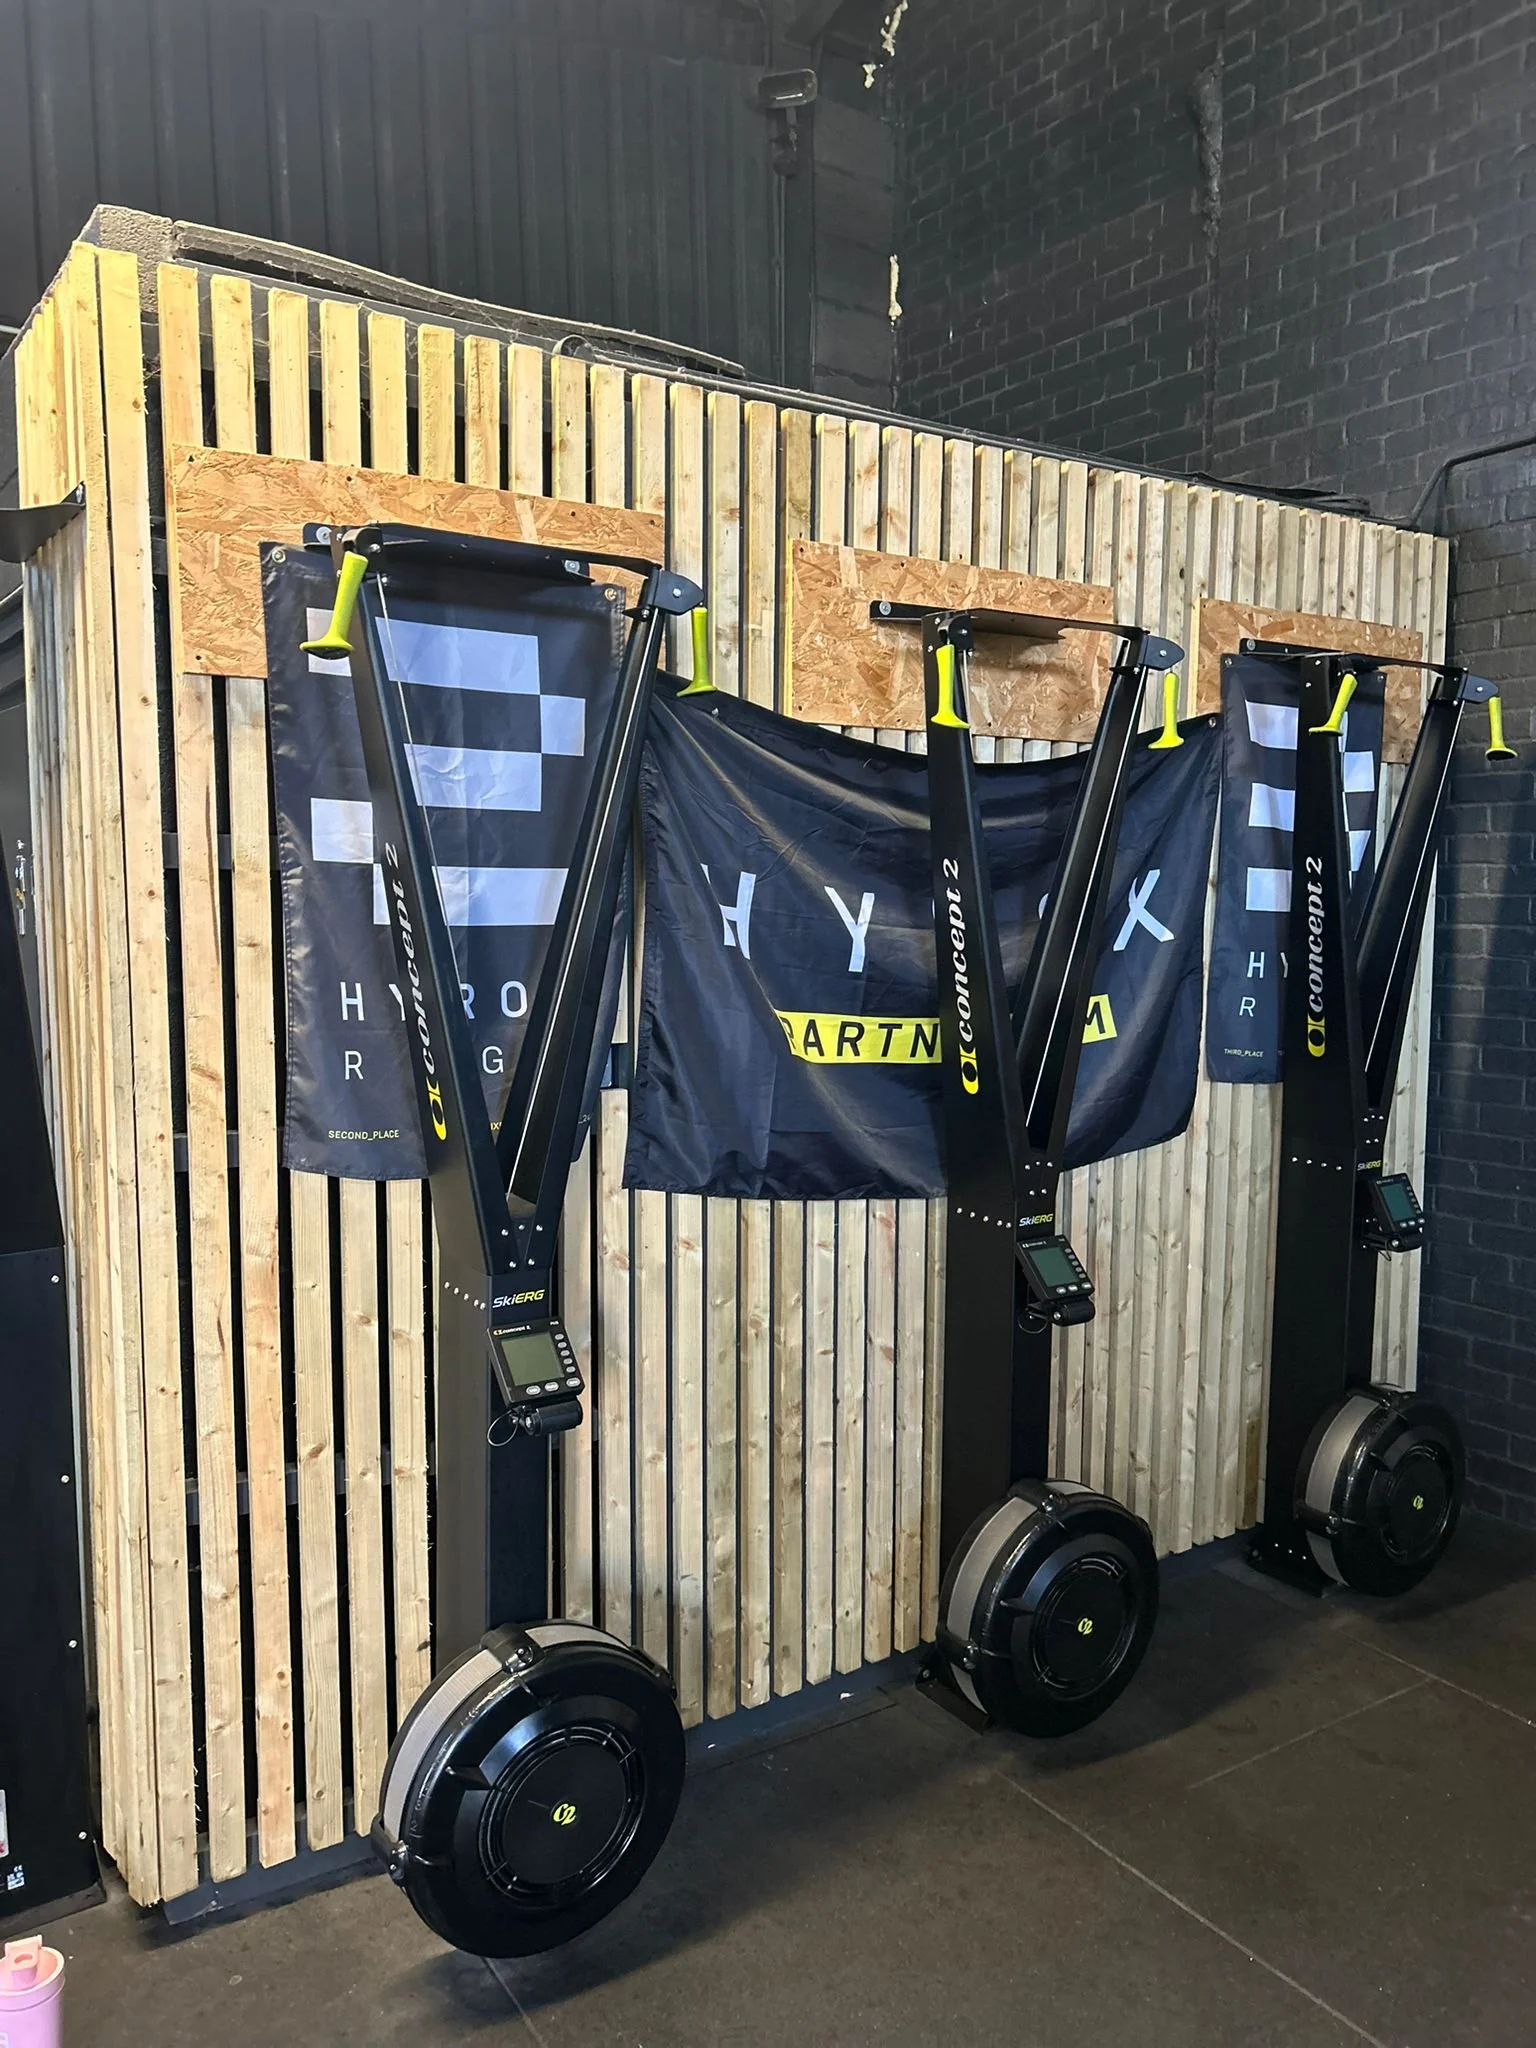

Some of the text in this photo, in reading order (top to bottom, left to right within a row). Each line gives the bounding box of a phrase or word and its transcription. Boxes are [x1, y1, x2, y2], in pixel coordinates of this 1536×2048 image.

[700, 863, 1175, 973] HYX
[1305, 856, 1325, 1014] concept 2
[385, 842, 437, 1076] concept 2
[943, 857, 973, 1043] concept 2
[1223, 1048, 1264, 1058] THIRD_PLACE
[328, 1128, 400, 1142] SECOND_PLACE
[1019, 1213, 1053, 1227] SkiERG
[492, 1289, 545, 1308] SkiERG
[552, 1803, 577, 1826] C2
